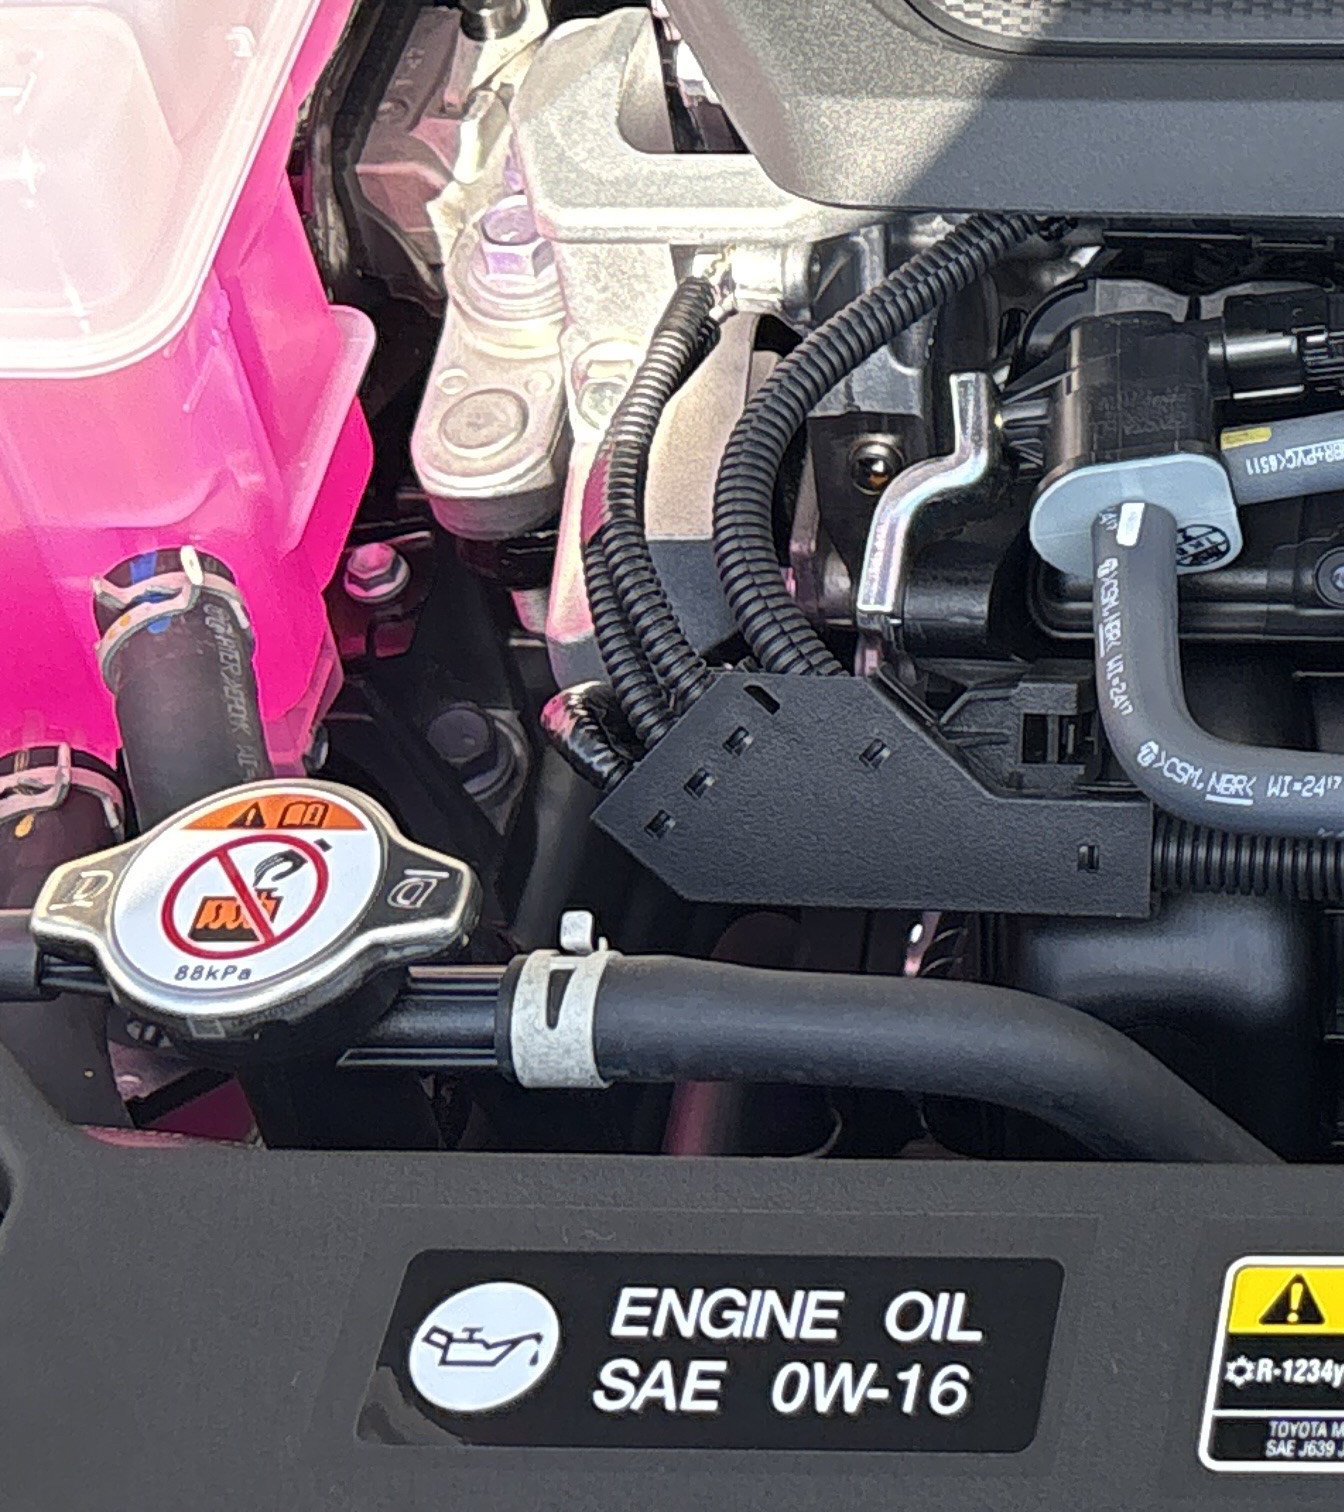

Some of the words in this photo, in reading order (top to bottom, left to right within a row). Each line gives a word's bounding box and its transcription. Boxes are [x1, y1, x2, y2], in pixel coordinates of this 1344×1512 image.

[174, 963, 251, 982] 88kPa
[610, 1286, 845, 1341] ENGINE
[884, 1289, 983, 1342] OIL
[593, 1359, 726, 1413] SAE
[772, 1362, 970, 1417] 0W-16
[1268, 1420, 1328, 1439] TOYOTA
[1265, 1440, 1297, 1458] SAE
[1298, 1440, 1336, 1458] J639
